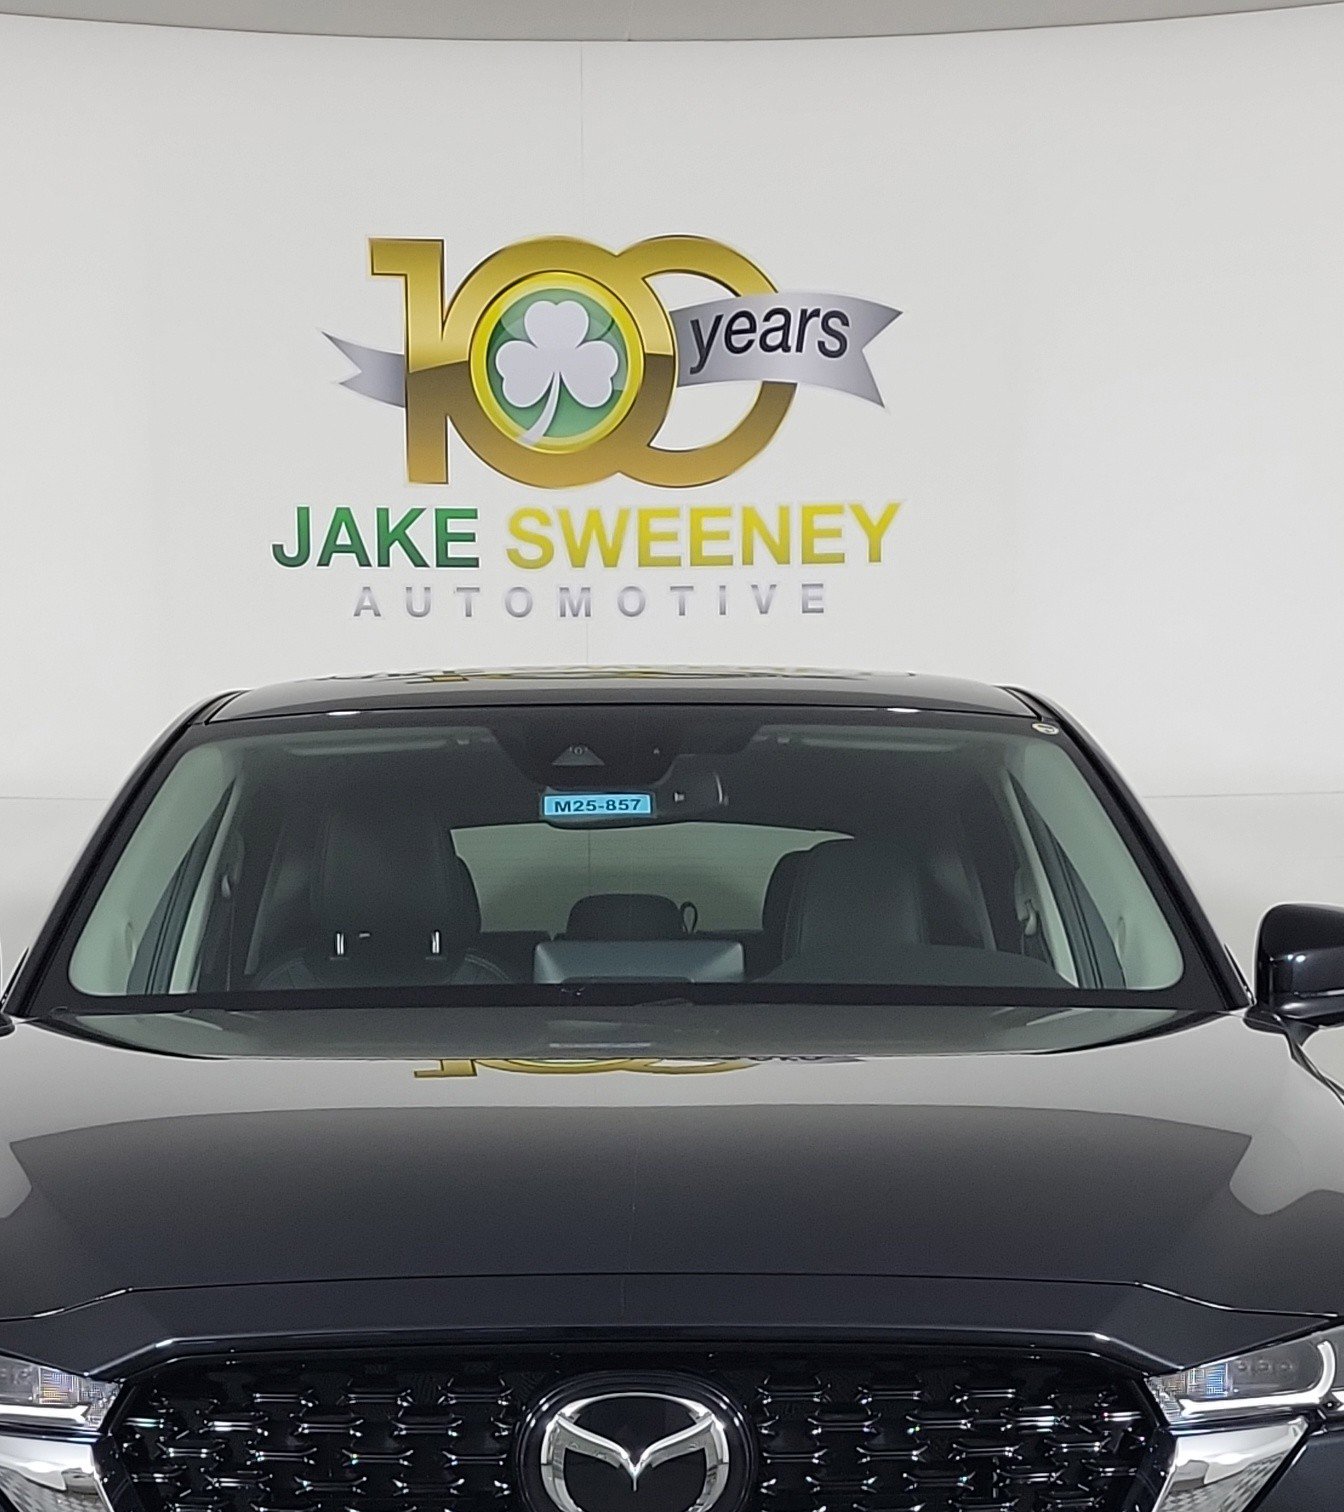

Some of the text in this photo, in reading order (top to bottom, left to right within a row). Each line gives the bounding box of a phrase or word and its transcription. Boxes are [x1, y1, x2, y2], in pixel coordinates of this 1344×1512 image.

[367, 234, 851, 489] 100 years
[271, 502, 902, 570] JAKE SWEENEY
[353, 582, 826, 619] AUTOMOTIVE
[555, 799, 642, 813] M25-857
